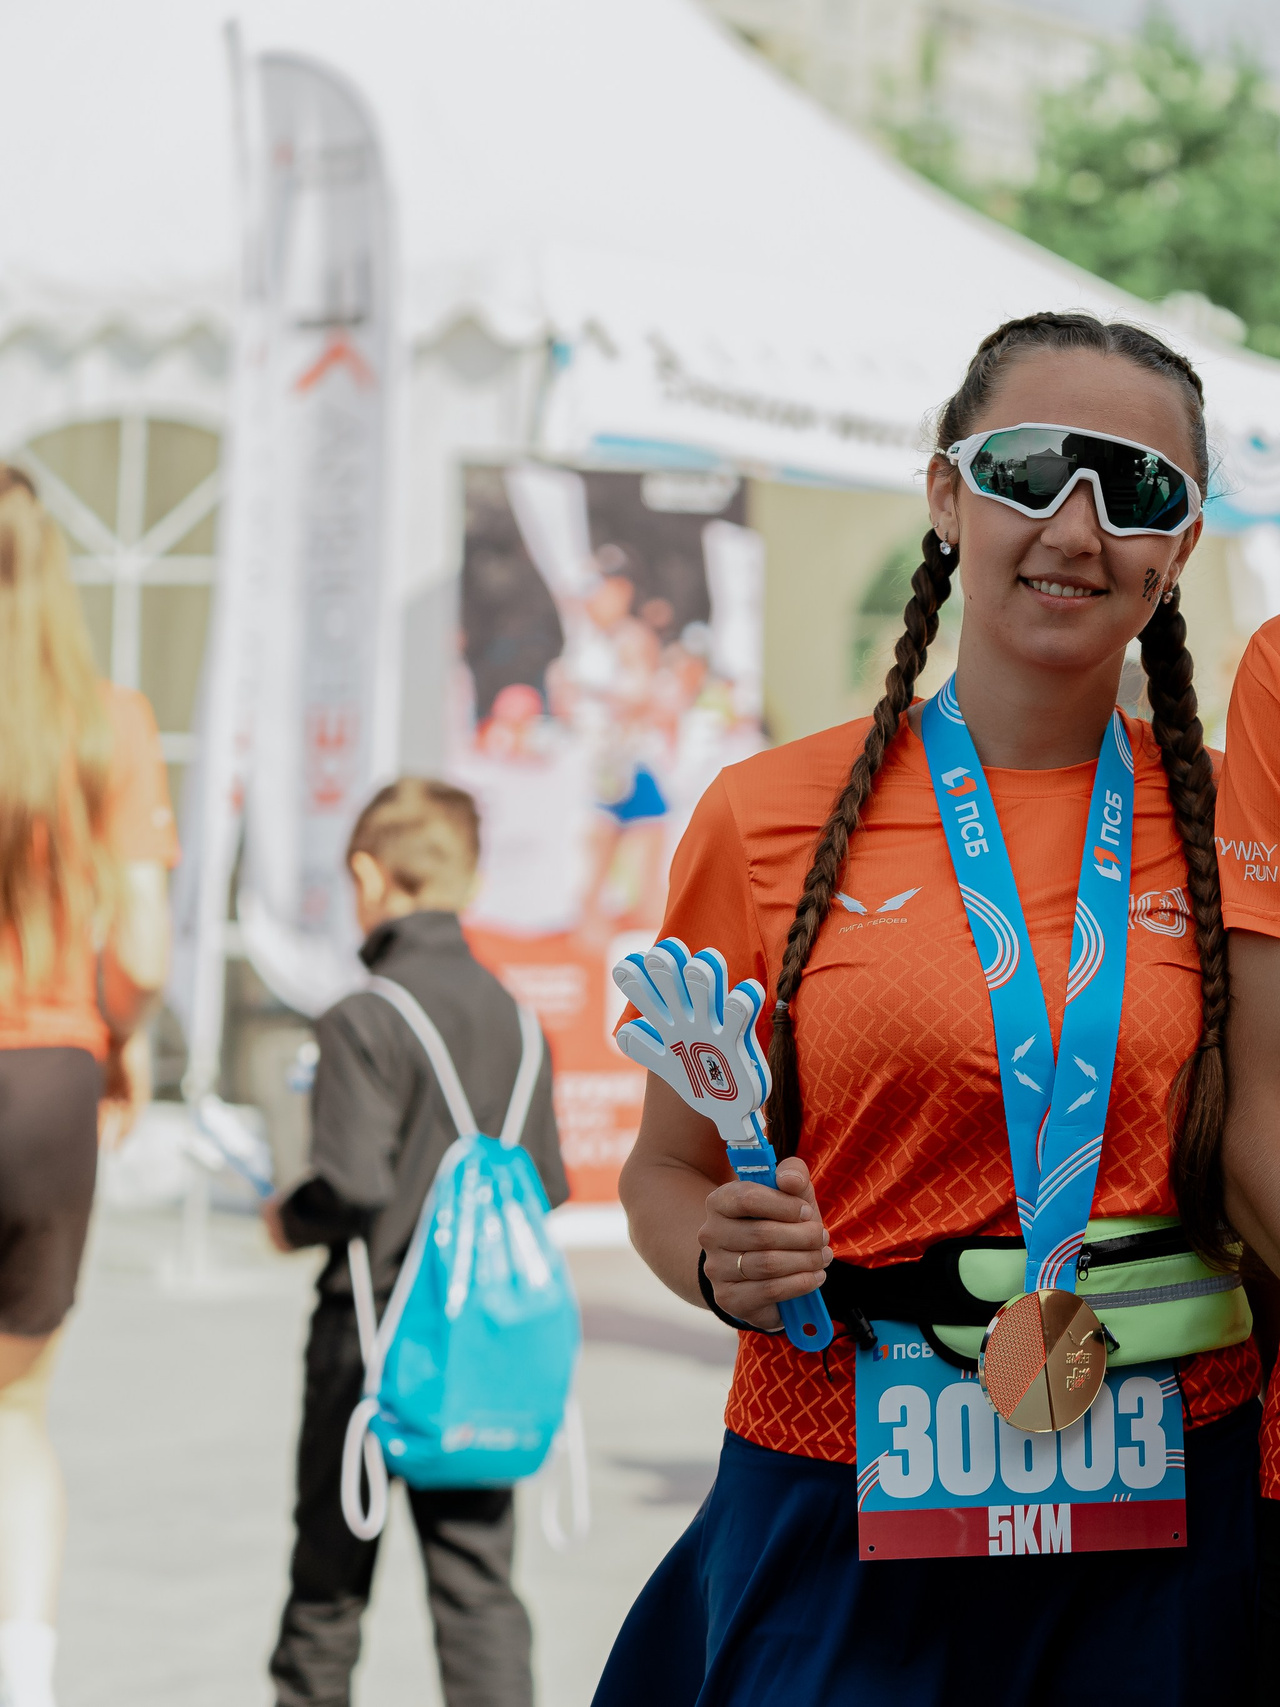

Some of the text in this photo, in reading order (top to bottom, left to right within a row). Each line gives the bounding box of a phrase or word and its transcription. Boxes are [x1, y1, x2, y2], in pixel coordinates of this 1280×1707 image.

[954, 800, 989, 858] ПСБ
[1100, 789, 1123, 846] ПСБ
[1214, 836, 1278, 862] YWAY
[1243, 863, 1279, 883] RUN
[838, 917, 908, 934] ЛИГА ГЕРОЕВ
[669, 1040, 739, 1102] 10
[893, 1342, 935, 1360] ПСБ
